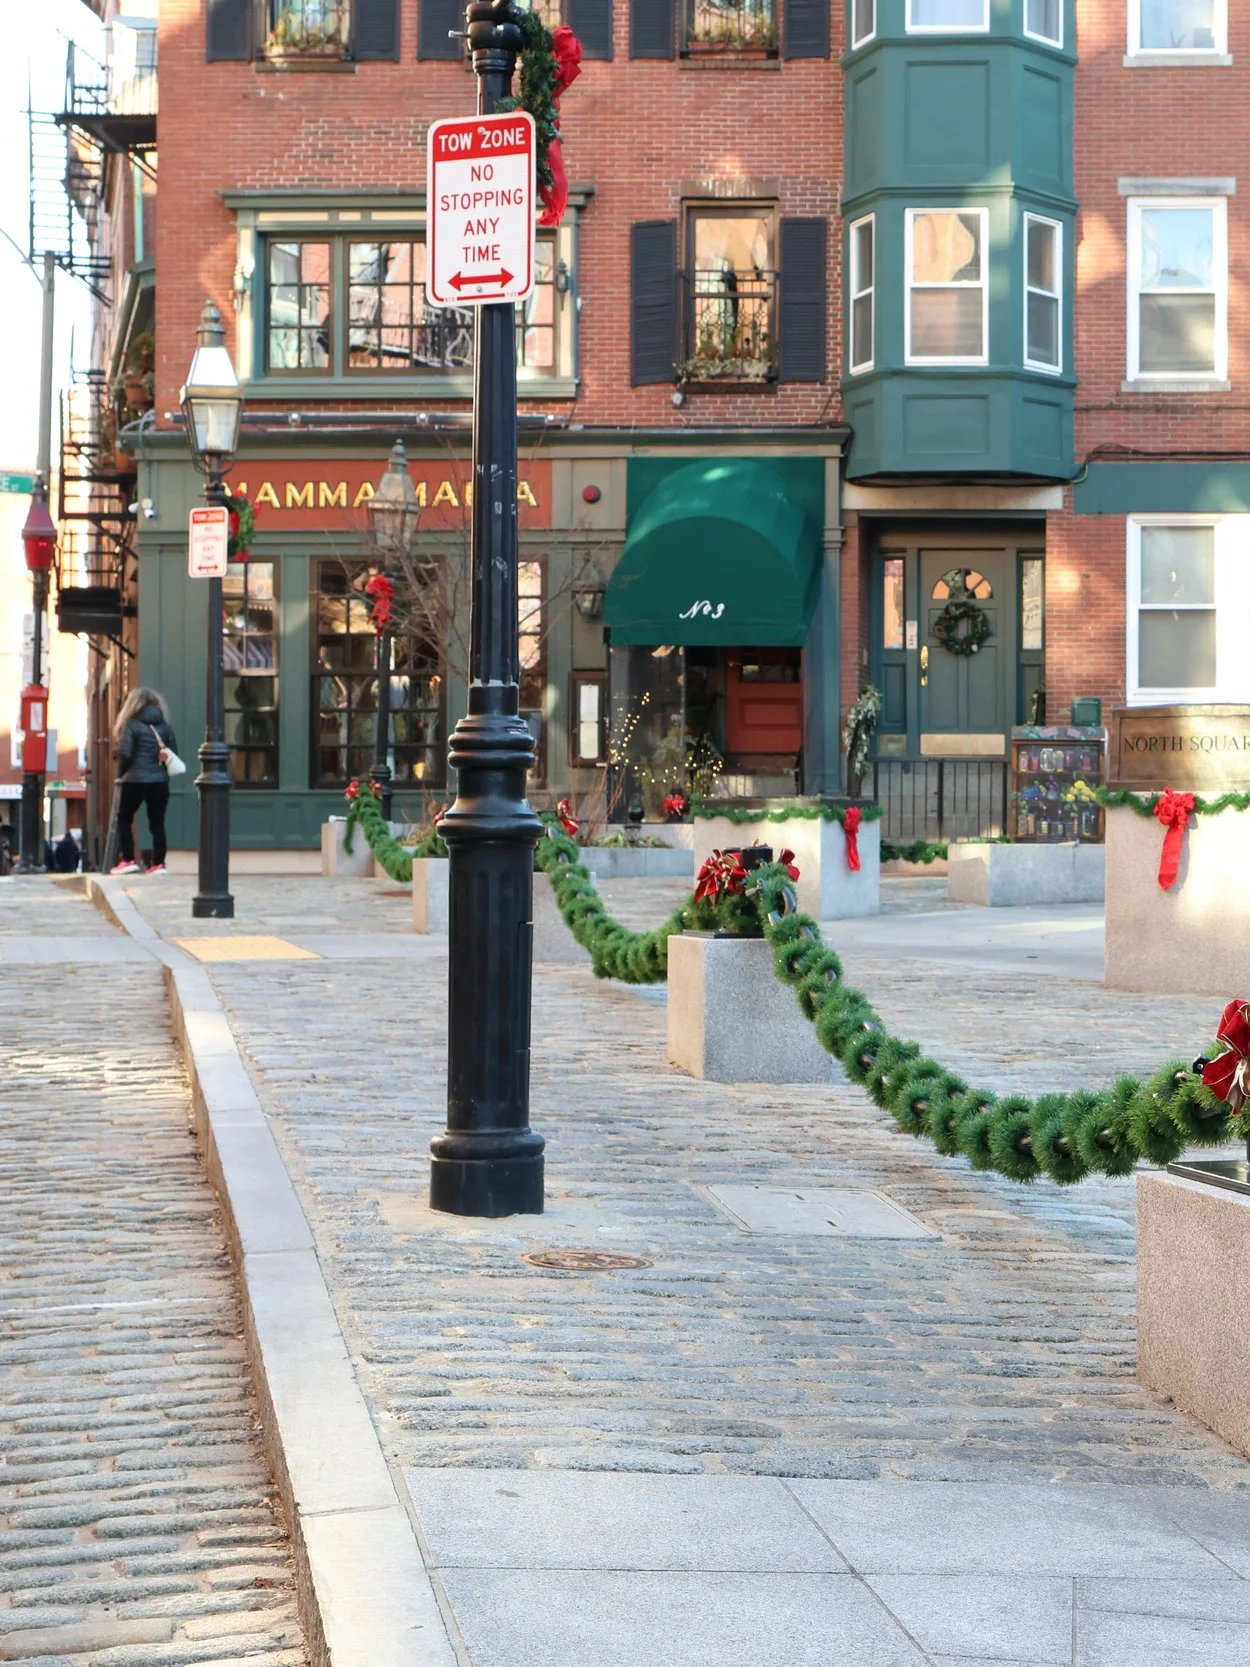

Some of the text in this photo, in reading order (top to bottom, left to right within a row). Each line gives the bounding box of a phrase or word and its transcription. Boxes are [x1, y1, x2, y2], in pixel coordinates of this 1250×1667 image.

[438, 127, 526, 152] TOW ZONE
[471, 164, 494, 182] NO
[440, 188, 524, 212] STOPPING
[463, 217, 501, 237] ANY
[462, 244, 501, 264] TIME
[1123, 736, 1183, 752] NORTH
